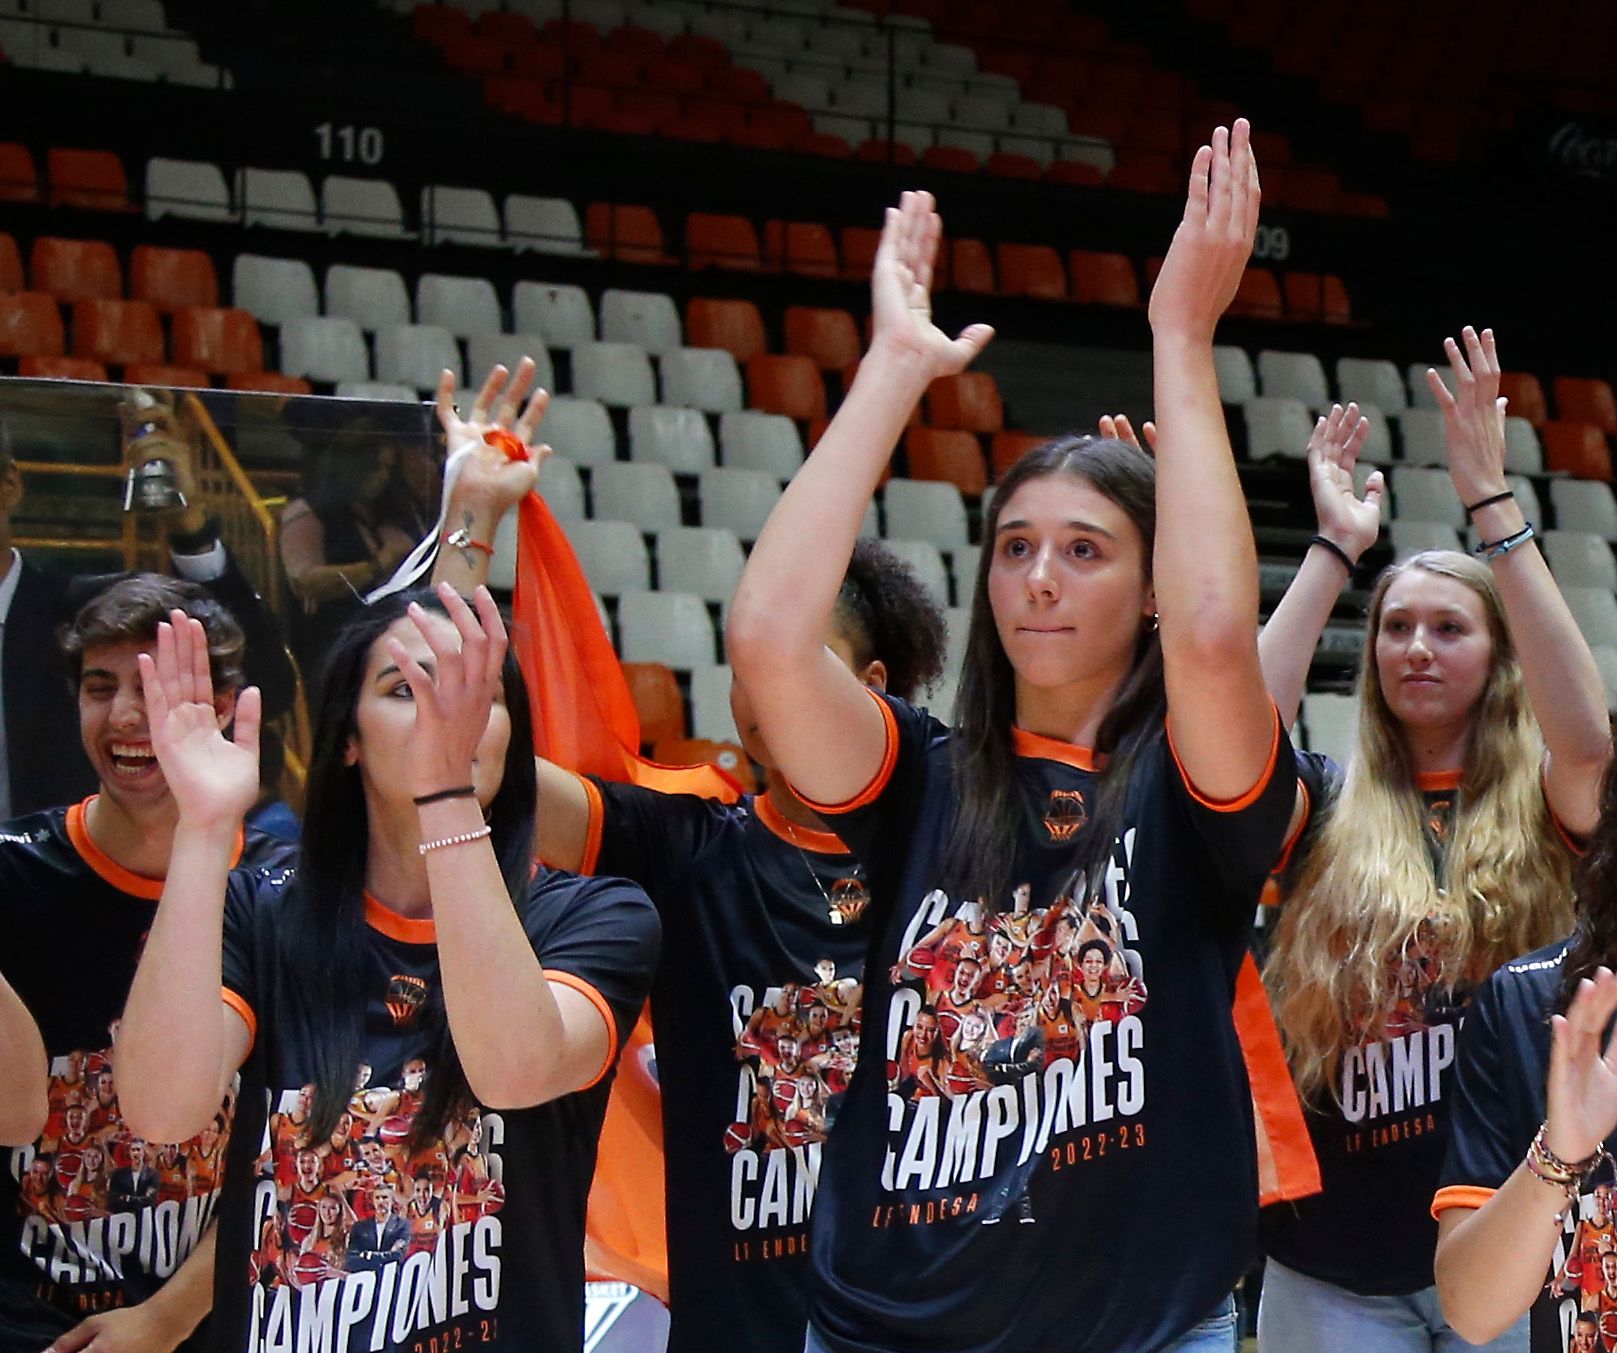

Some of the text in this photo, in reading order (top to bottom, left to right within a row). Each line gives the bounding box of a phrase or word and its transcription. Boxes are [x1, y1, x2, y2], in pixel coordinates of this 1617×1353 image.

[314, 122, 383, 165] 110
[1255, 226, 1290, 260] 09
[881, 1015, 1145, 1192] CAMPIONES
[1050, 1123, 1146, 1172] 2022-23
